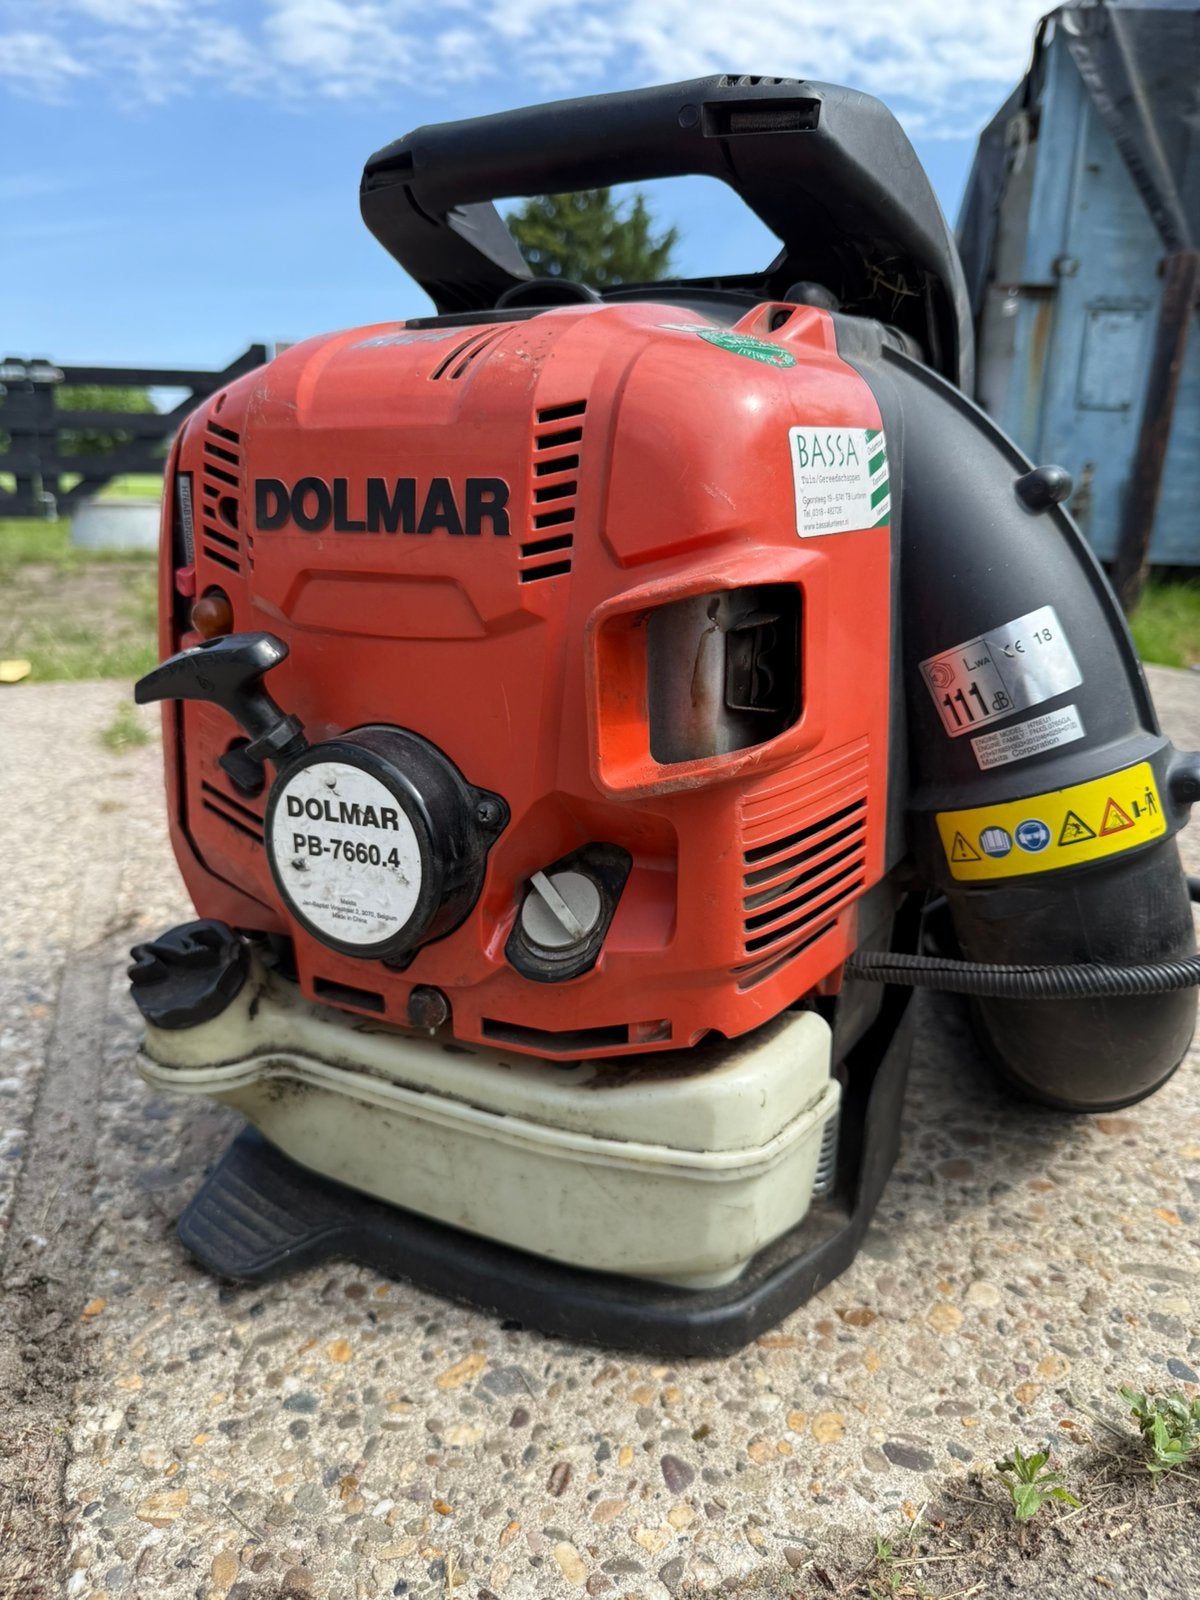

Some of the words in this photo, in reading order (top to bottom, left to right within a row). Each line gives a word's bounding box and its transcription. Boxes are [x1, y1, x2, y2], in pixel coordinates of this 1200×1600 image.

[797, 434, 859, 468] BASSA
[255, 476, 511, 536] DOLMAR
[1033, 628, 1053, 644] 18
[943, 682, 990, 727] 111
[992, 691, 1010, 711] dB
[974, 734, 998, 747] ENGINE
[999, 727, 1023, 740] MODEL
[977, 741, 1002, 754] ENGINE
[981, 754, 1009, 767] Makita
[1011, 736, 1060, 757] Corporation
[286, 795, 399, 831] DOLMAR
[293, 833, 400, 868] PB-7660.4
